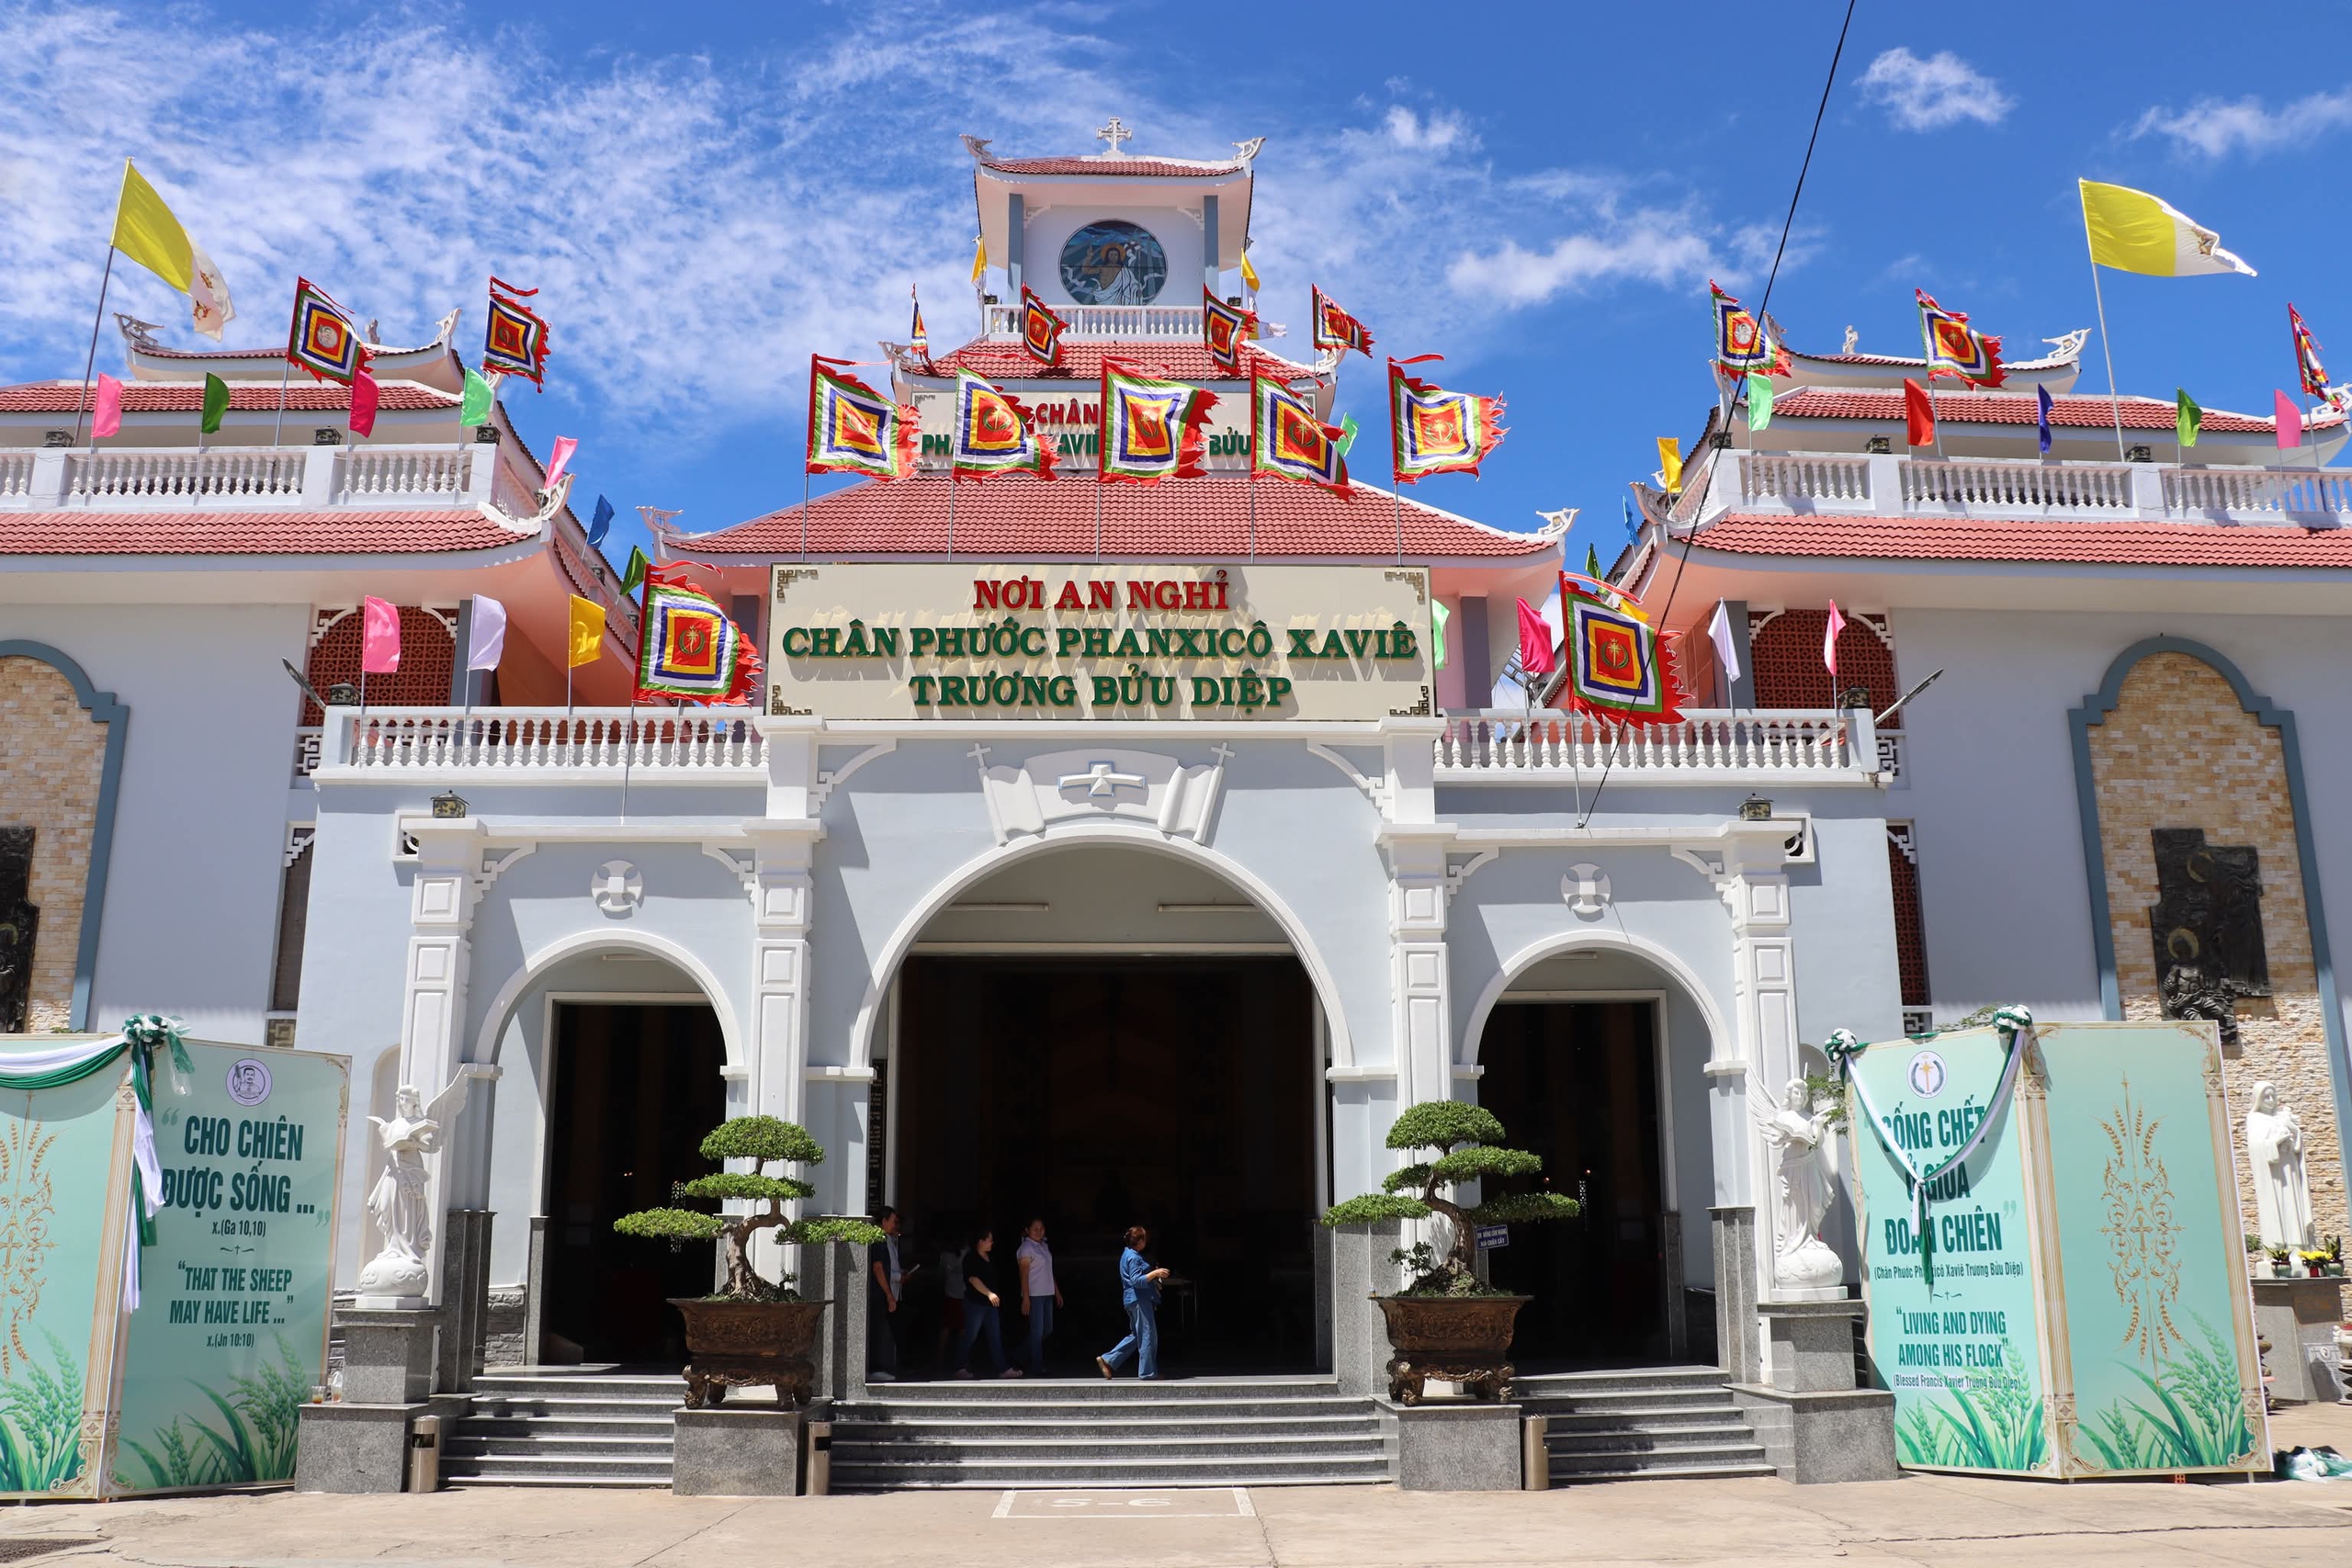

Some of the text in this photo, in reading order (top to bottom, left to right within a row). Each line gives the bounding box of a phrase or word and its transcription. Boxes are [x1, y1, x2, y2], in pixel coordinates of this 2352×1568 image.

[1035, 398, 1099, 424] CHÂN
[1209, 426, 1251, 456] BỬU
[973, 570, 1229, 610] NƠI AN NGHỈ
[782, 616, 1418, 659] CHÂN PHƯỚC PHANXICÔ XAVIÊ
[908, 663, 1292, 714] TRƯƠNG BỬU DIỆP
[238, 1114, 304, 1162] CHIÊN
[161, 1166, 224, 1218] ĐƯỢC
[230, 1160, 291, 1213] SỐNG
[239, 1221, 266, 1237] 10,10)
[221, 1268, 246, 1292] THE
[250, 1269, 293, 1292] SHEEP
[169, 1300, 201, 1324] MAY
[204, 1301, 239, 1324] HAVE
[243, 1301, 270, 1324] LIFE
[1943, 1312, 1967, 1335] AND
[1970, 1311, 2007, 1335] DYING
[231, 1333, 254, 1348] 10:10)
[1898, 1343, 1940, 1367] AMONG
[1942, 1344, 1963, 1367] HIS
[1920, 1374, 1943, 1387] Francis
